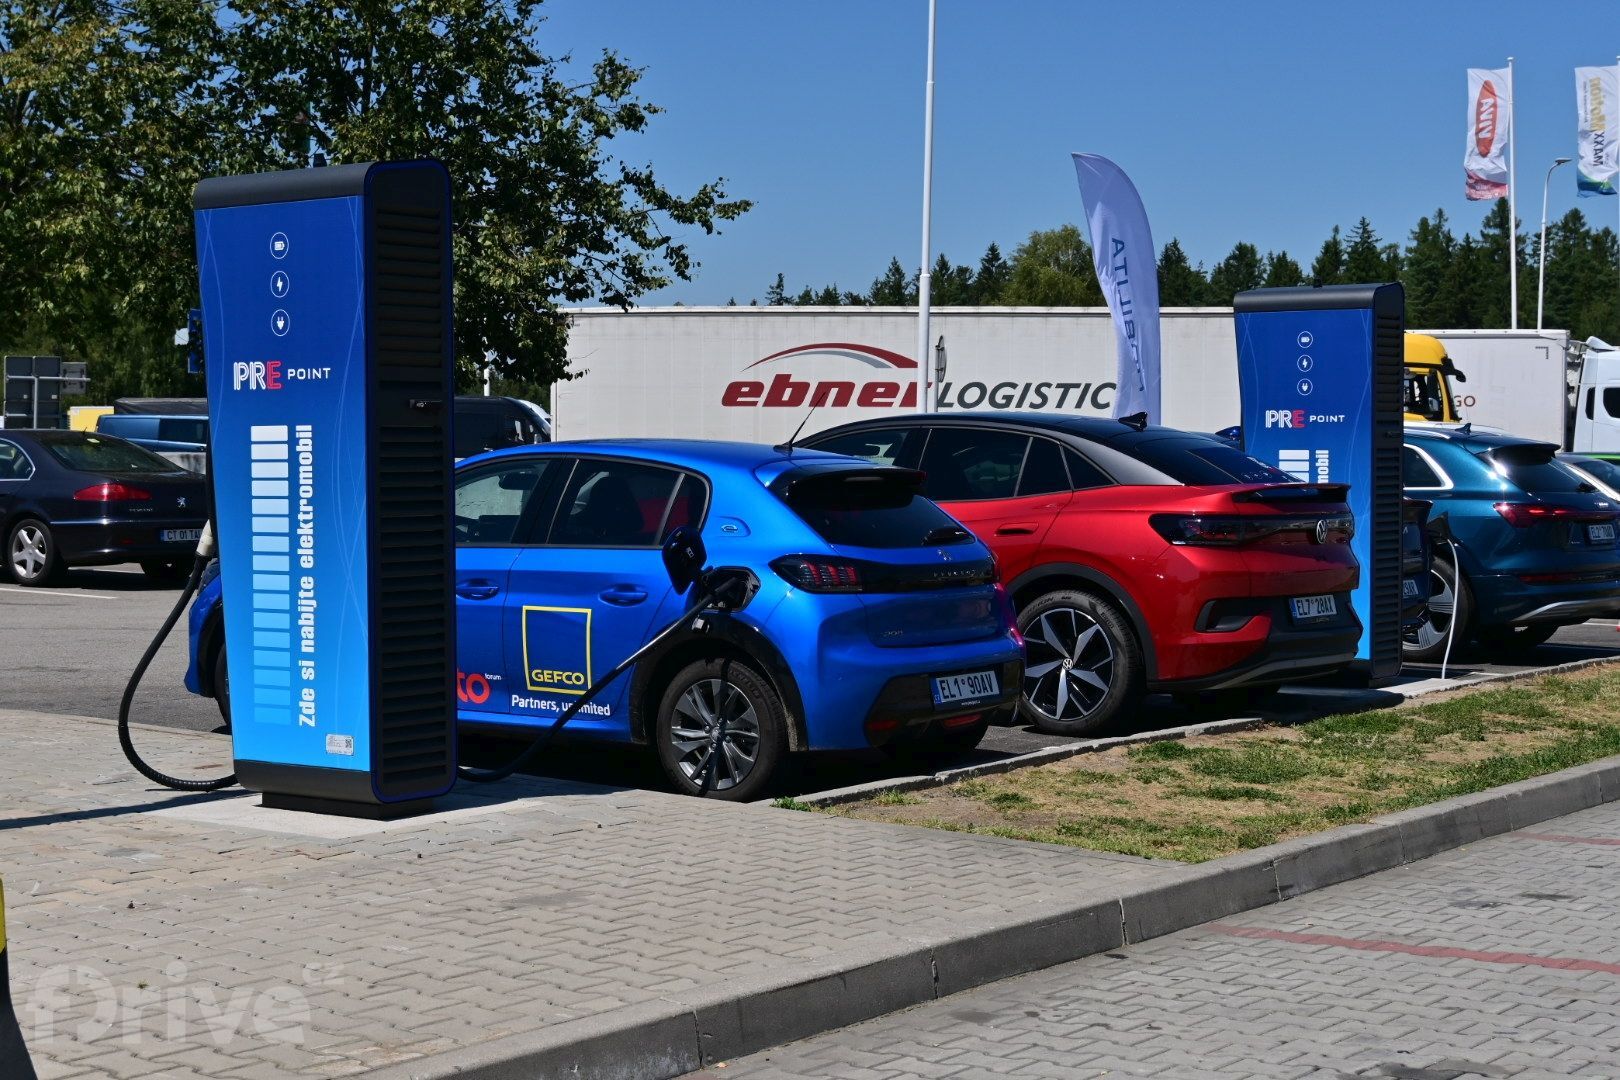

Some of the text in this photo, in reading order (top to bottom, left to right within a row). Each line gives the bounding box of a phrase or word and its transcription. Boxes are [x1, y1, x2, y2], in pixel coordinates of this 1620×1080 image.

[233, 361, 331, 390] PRE POINT
[721, 374, 932, 408] ebner
[1265, 409, 1345, 428] PRE POINT
[295, 425, 317, 727] Zde si nabijte elektromobil
[531, 669, 585, 685] GEFCO
[511, 694, 560, 712] Partners,
